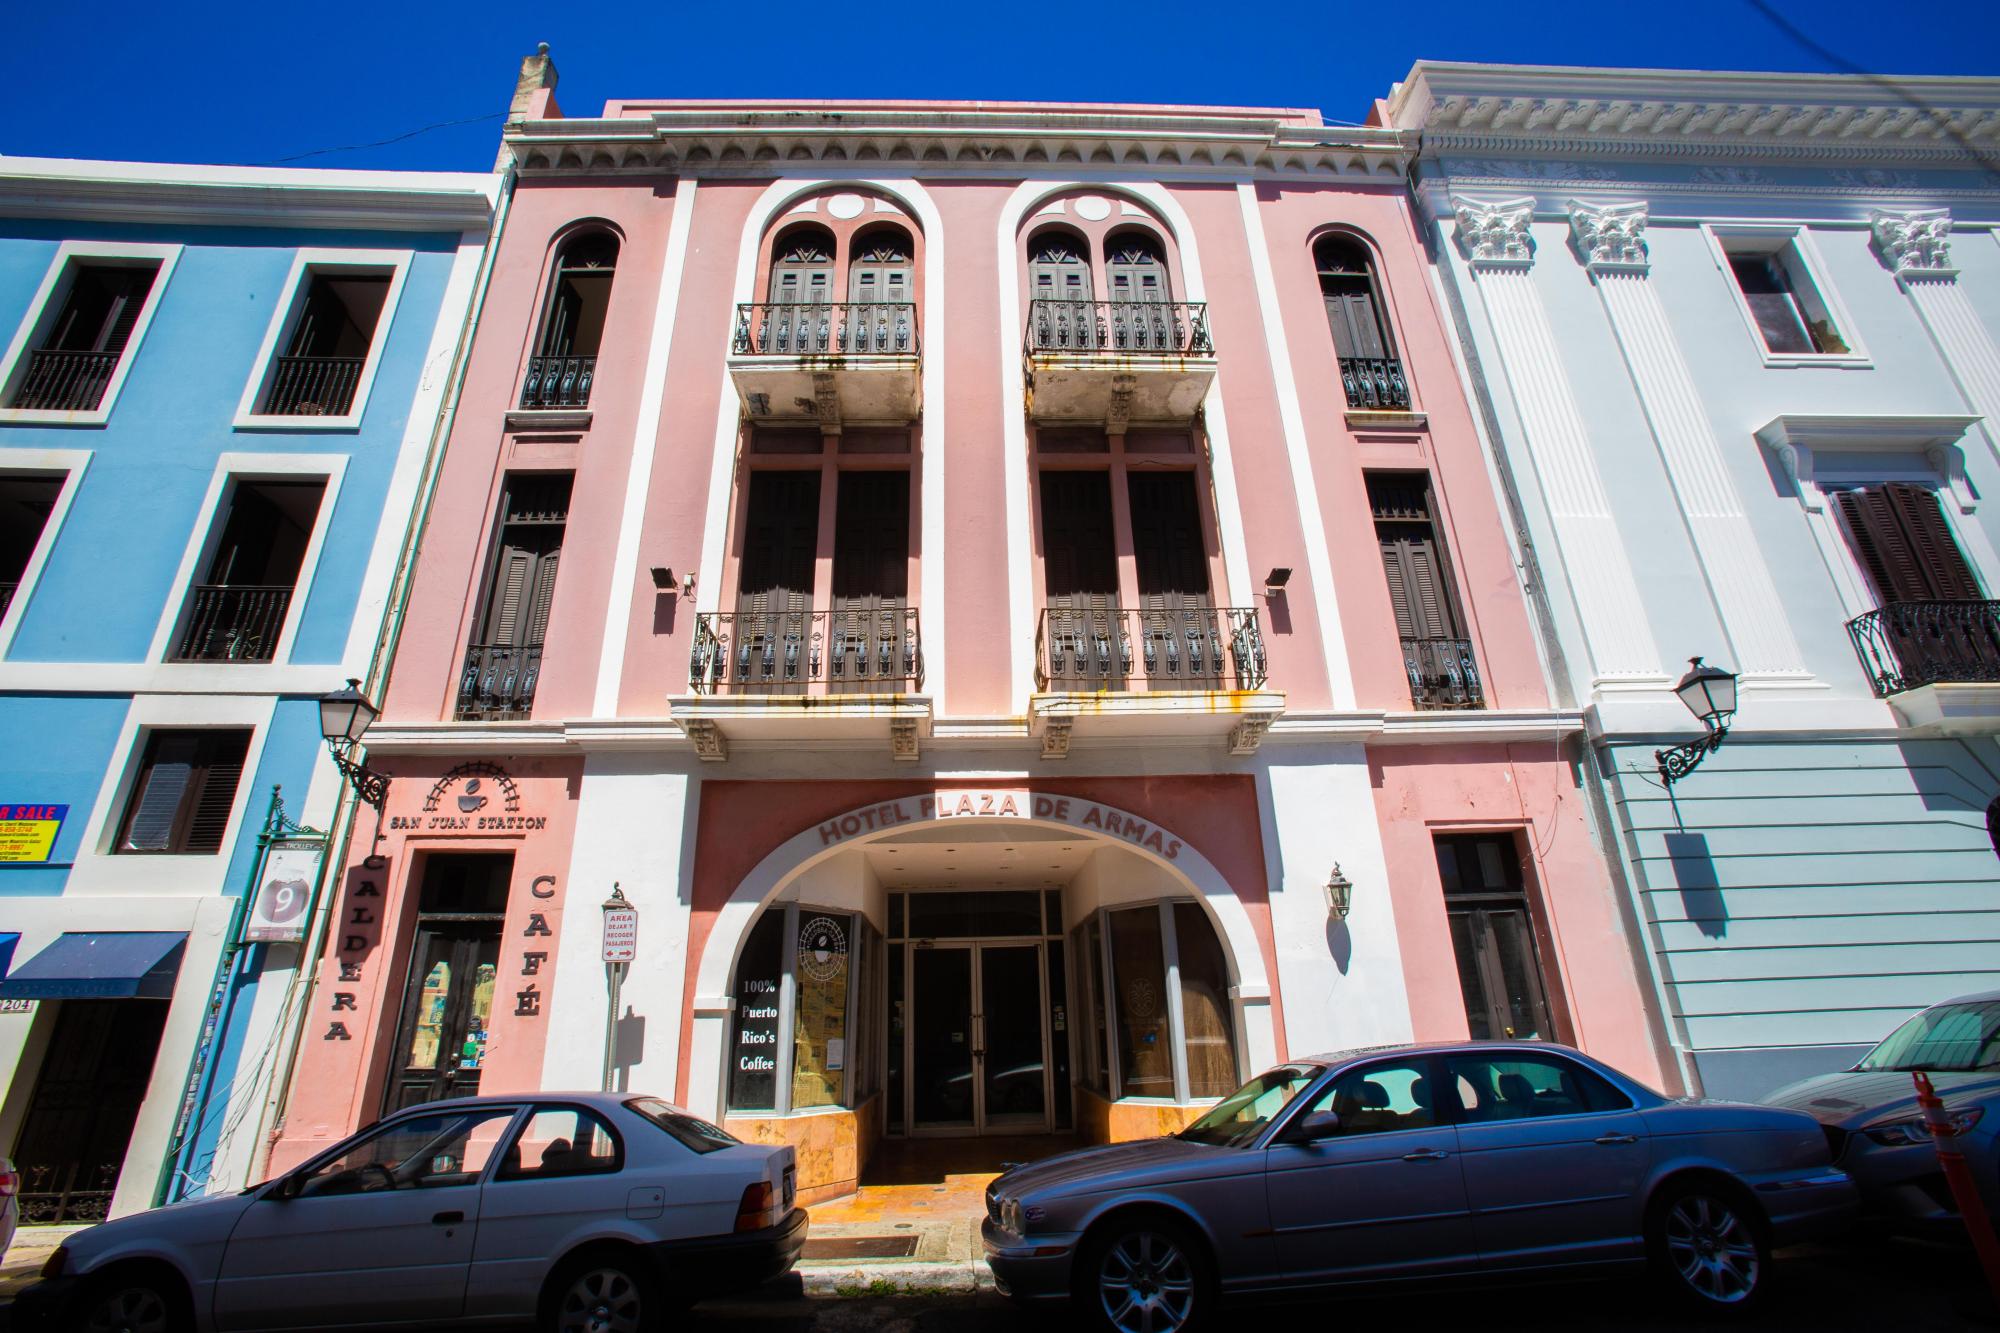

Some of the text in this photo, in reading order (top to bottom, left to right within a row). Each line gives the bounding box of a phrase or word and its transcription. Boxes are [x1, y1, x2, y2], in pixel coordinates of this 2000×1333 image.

[14, 806, 57, 820] SALE
[390, 816, 547, 830] SAN JUAN STATION
[819, 793, 1184, 860] HOTEL PLAZA DE ARMAS
[275, 886, 294, 913] 9
[323, 855, 386, 1041] CALDERA
[513, 875, 557, 1016] CAFÉ
[744, 980, 776, 993] 100%
[3, 999, 30, 1010] 204
[742, 1005, 778, 1018] Puerto
[740, 1056, 774, 1070] Coffee
